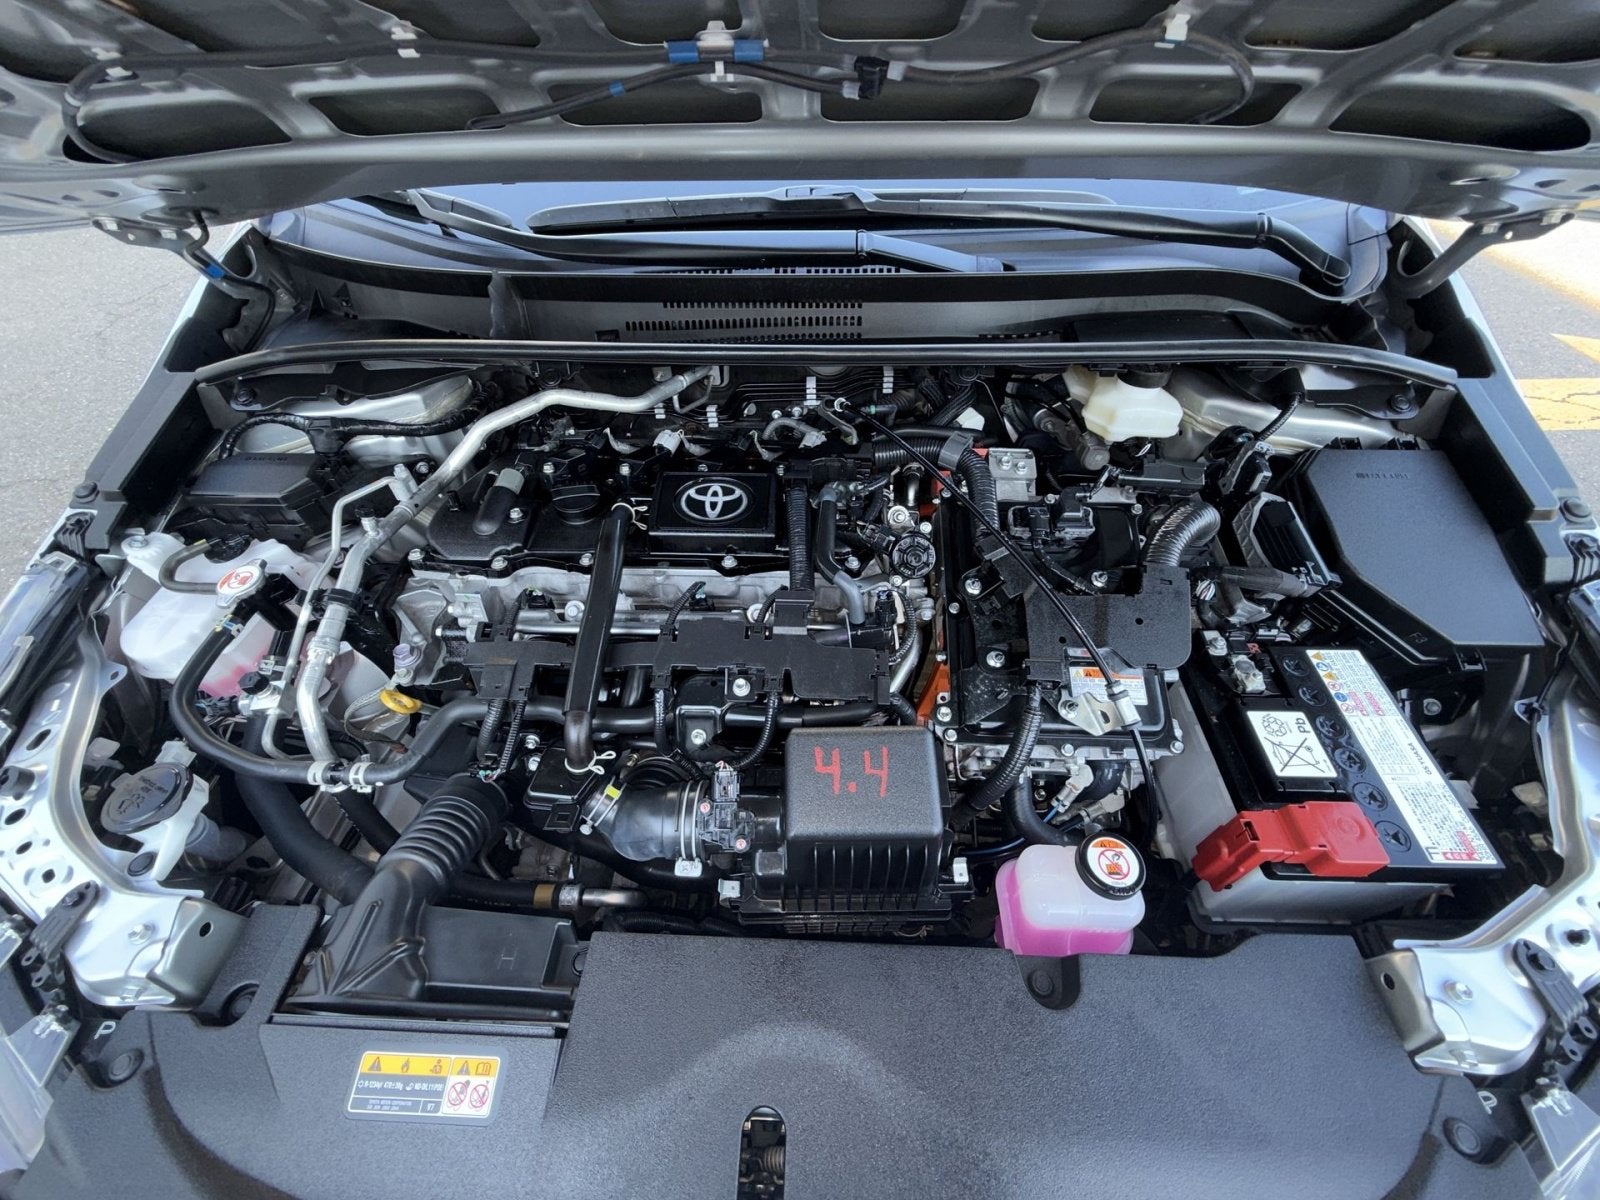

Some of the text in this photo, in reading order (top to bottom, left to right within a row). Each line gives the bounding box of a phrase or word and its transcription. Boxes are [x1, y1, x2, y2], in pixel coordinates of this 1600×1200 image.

[1295, 717, 1311, 734] Pb
[814, 745, 889, 797] 4.4
[94, 1020, 116, 1040] P
[1477, 1090, 1498, 1115] P
